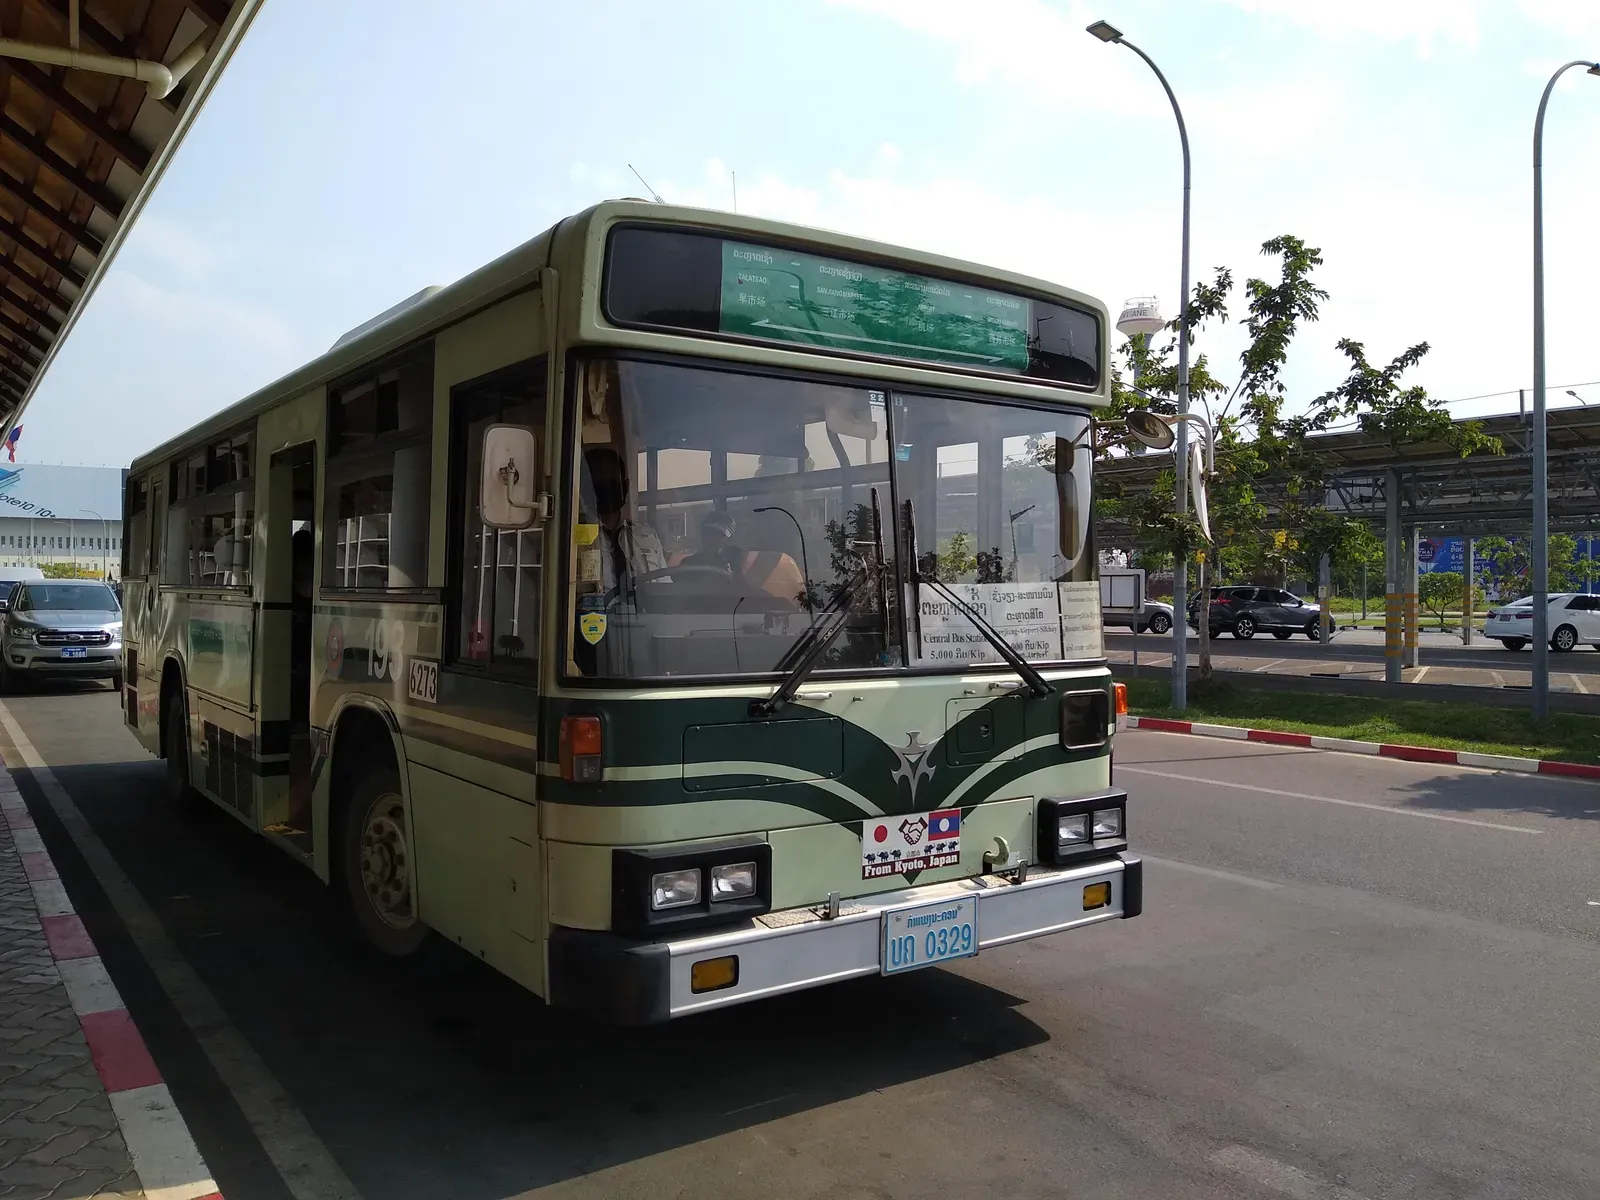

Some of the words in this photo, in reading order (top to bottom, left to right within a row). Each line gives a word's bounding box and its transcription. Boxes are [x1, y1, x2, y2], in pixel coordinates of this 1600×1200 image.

[738, 273, 767, 284] TALATSAO
[738, 292, 766, 308] 早市场
[821, 306, 856, 322] 三江市场
[923, 633, 950, 643] Central
[952, 633, 965, 643] Bus
[966, 633, 988, 643] Statio
[930, 650, 954, 660] 5,000
[410, 661, 437, 700] 6273
[864, 862, 892, 877] From
[895, 858, 927, 875] Kyoto,
[929, 853, 958, 868] Japan
[925, 923, 972, 959] 0329
